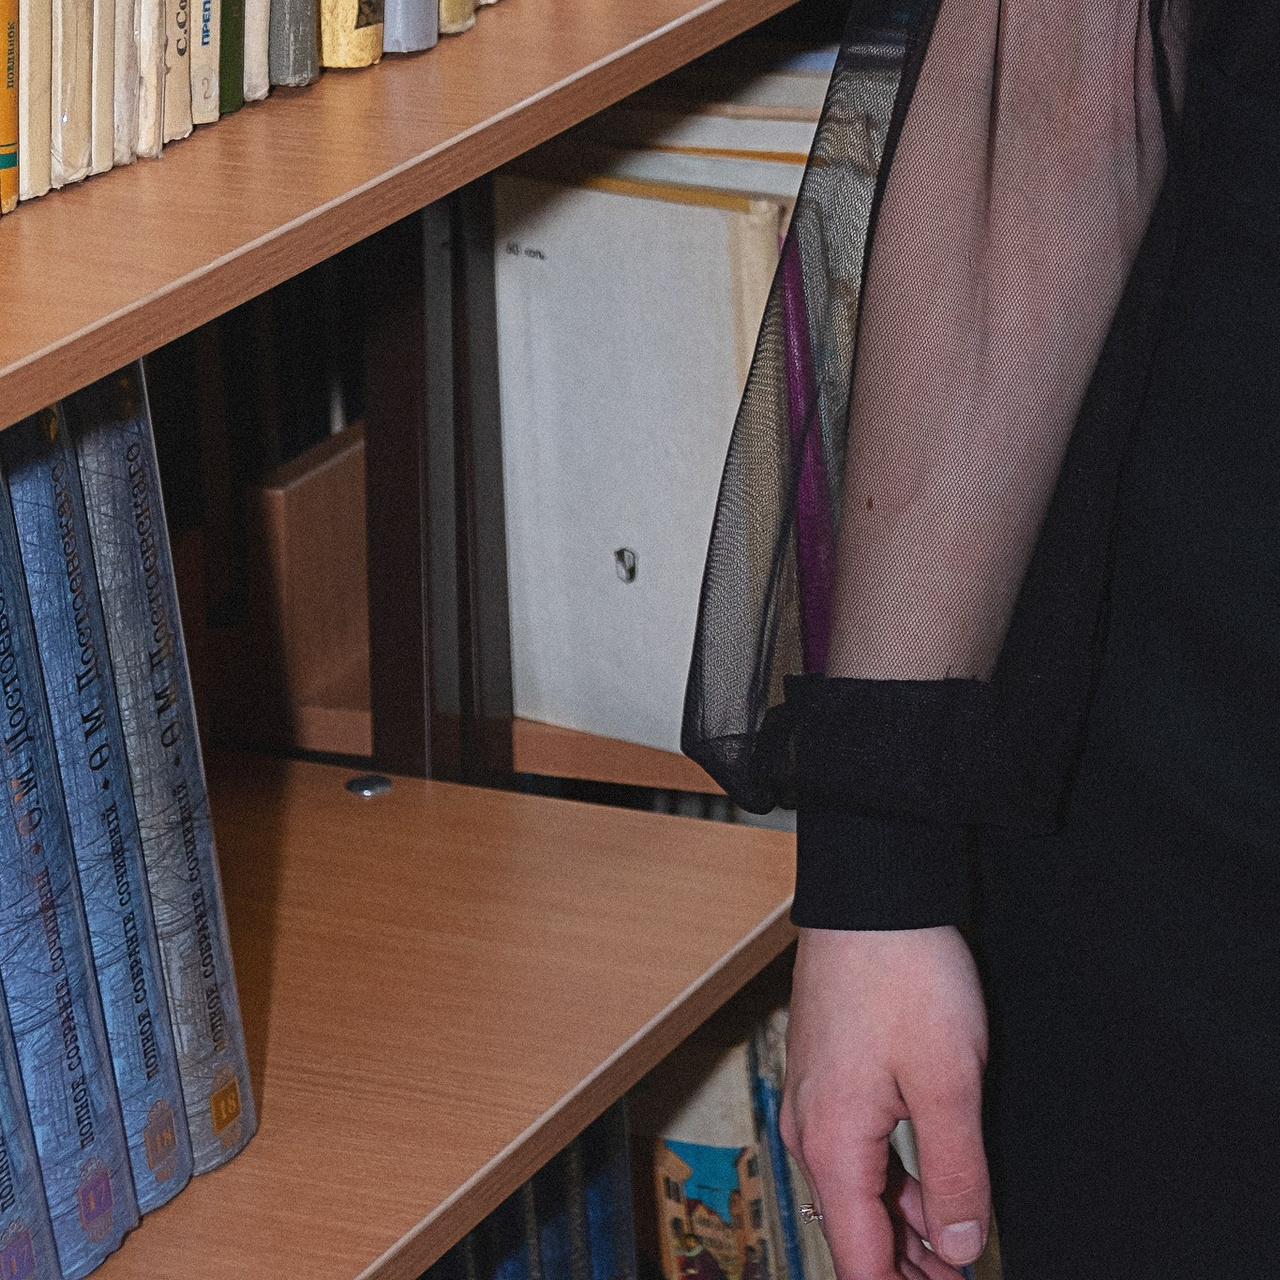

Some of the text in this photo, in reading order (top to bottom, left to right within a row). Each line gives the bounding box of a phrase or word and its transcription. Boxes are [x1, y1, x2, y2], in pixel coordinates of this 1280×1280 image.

[135, 1004, 160, 1083] ПОЛНОЕ
[207, 983, 226, 1053] ПОЛНОЕ
[70, 1075, 96, 1151] ПОЛНОЕ
